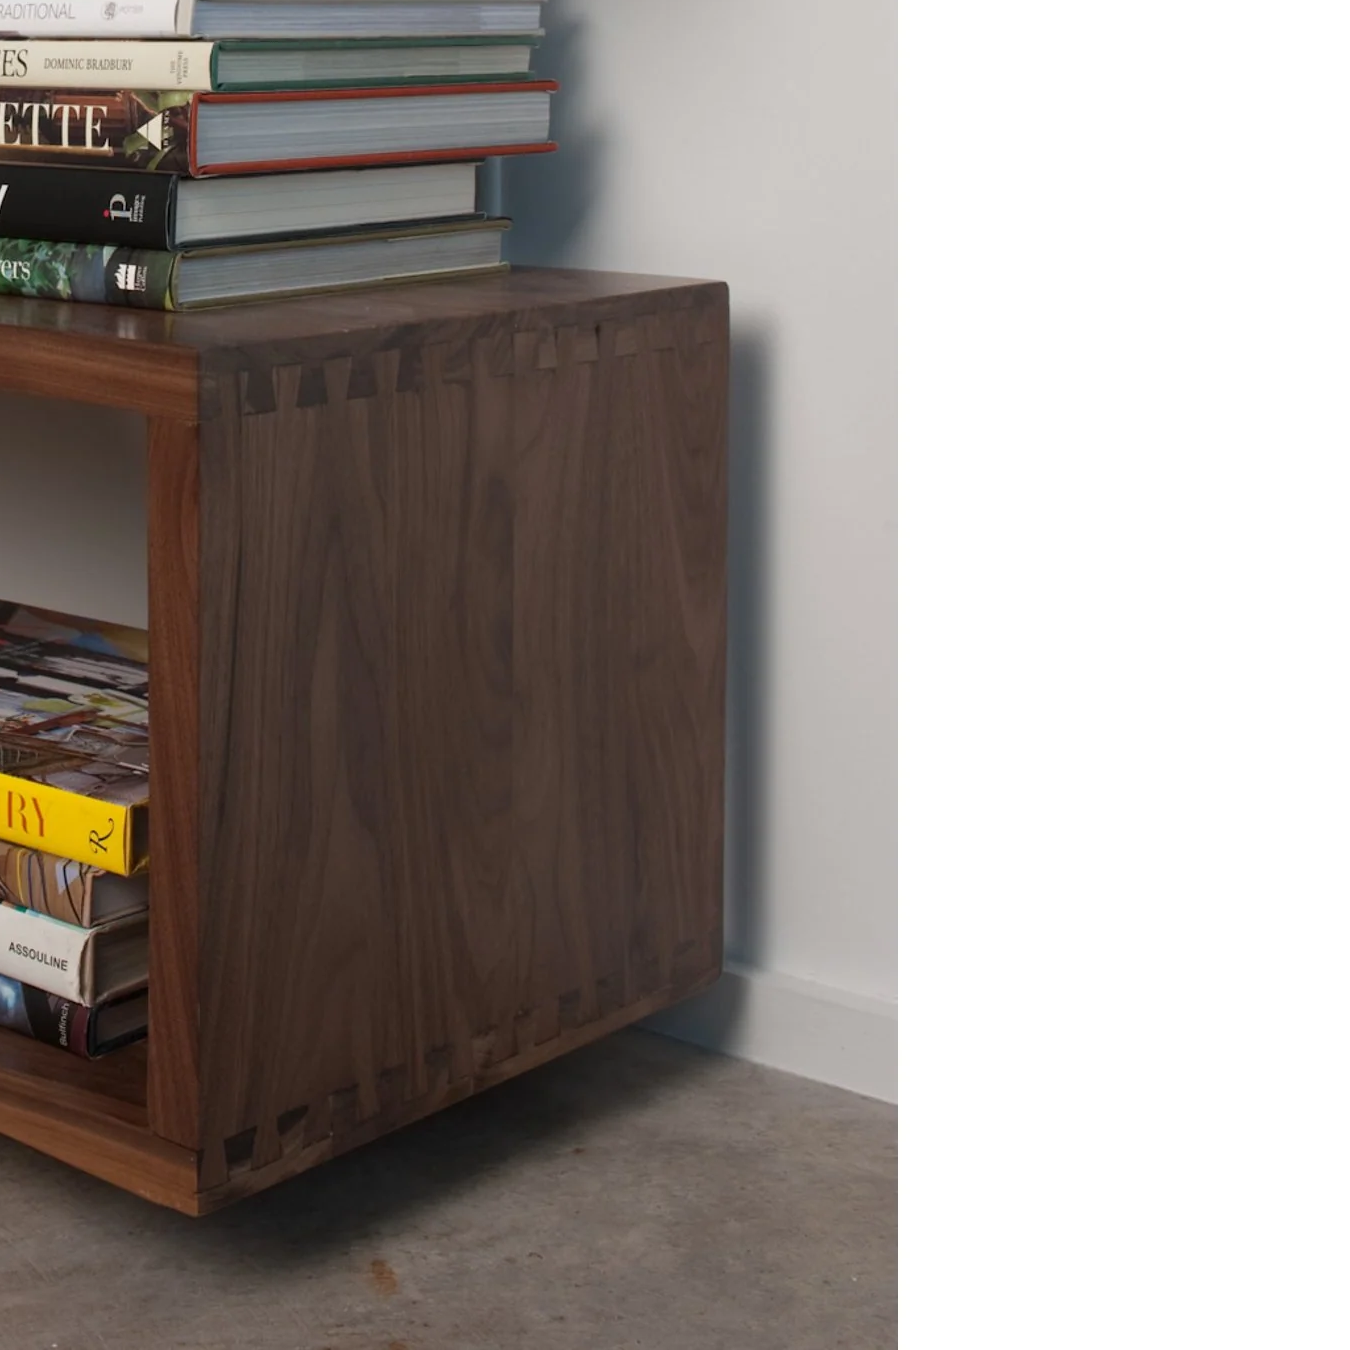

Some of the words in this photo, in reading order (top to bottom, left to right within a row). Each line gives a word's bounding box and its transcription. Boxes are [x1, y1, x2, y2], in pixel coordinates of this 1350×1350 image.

[43, 56, 86, 71] DOMINIC
[85, 57, 134, 72] BRADBURY
[88, 817, 115, 854] R
[8, 941, 69, 972] ASSOULINE
[58, 1001, 71, 1047] Bulfinch
